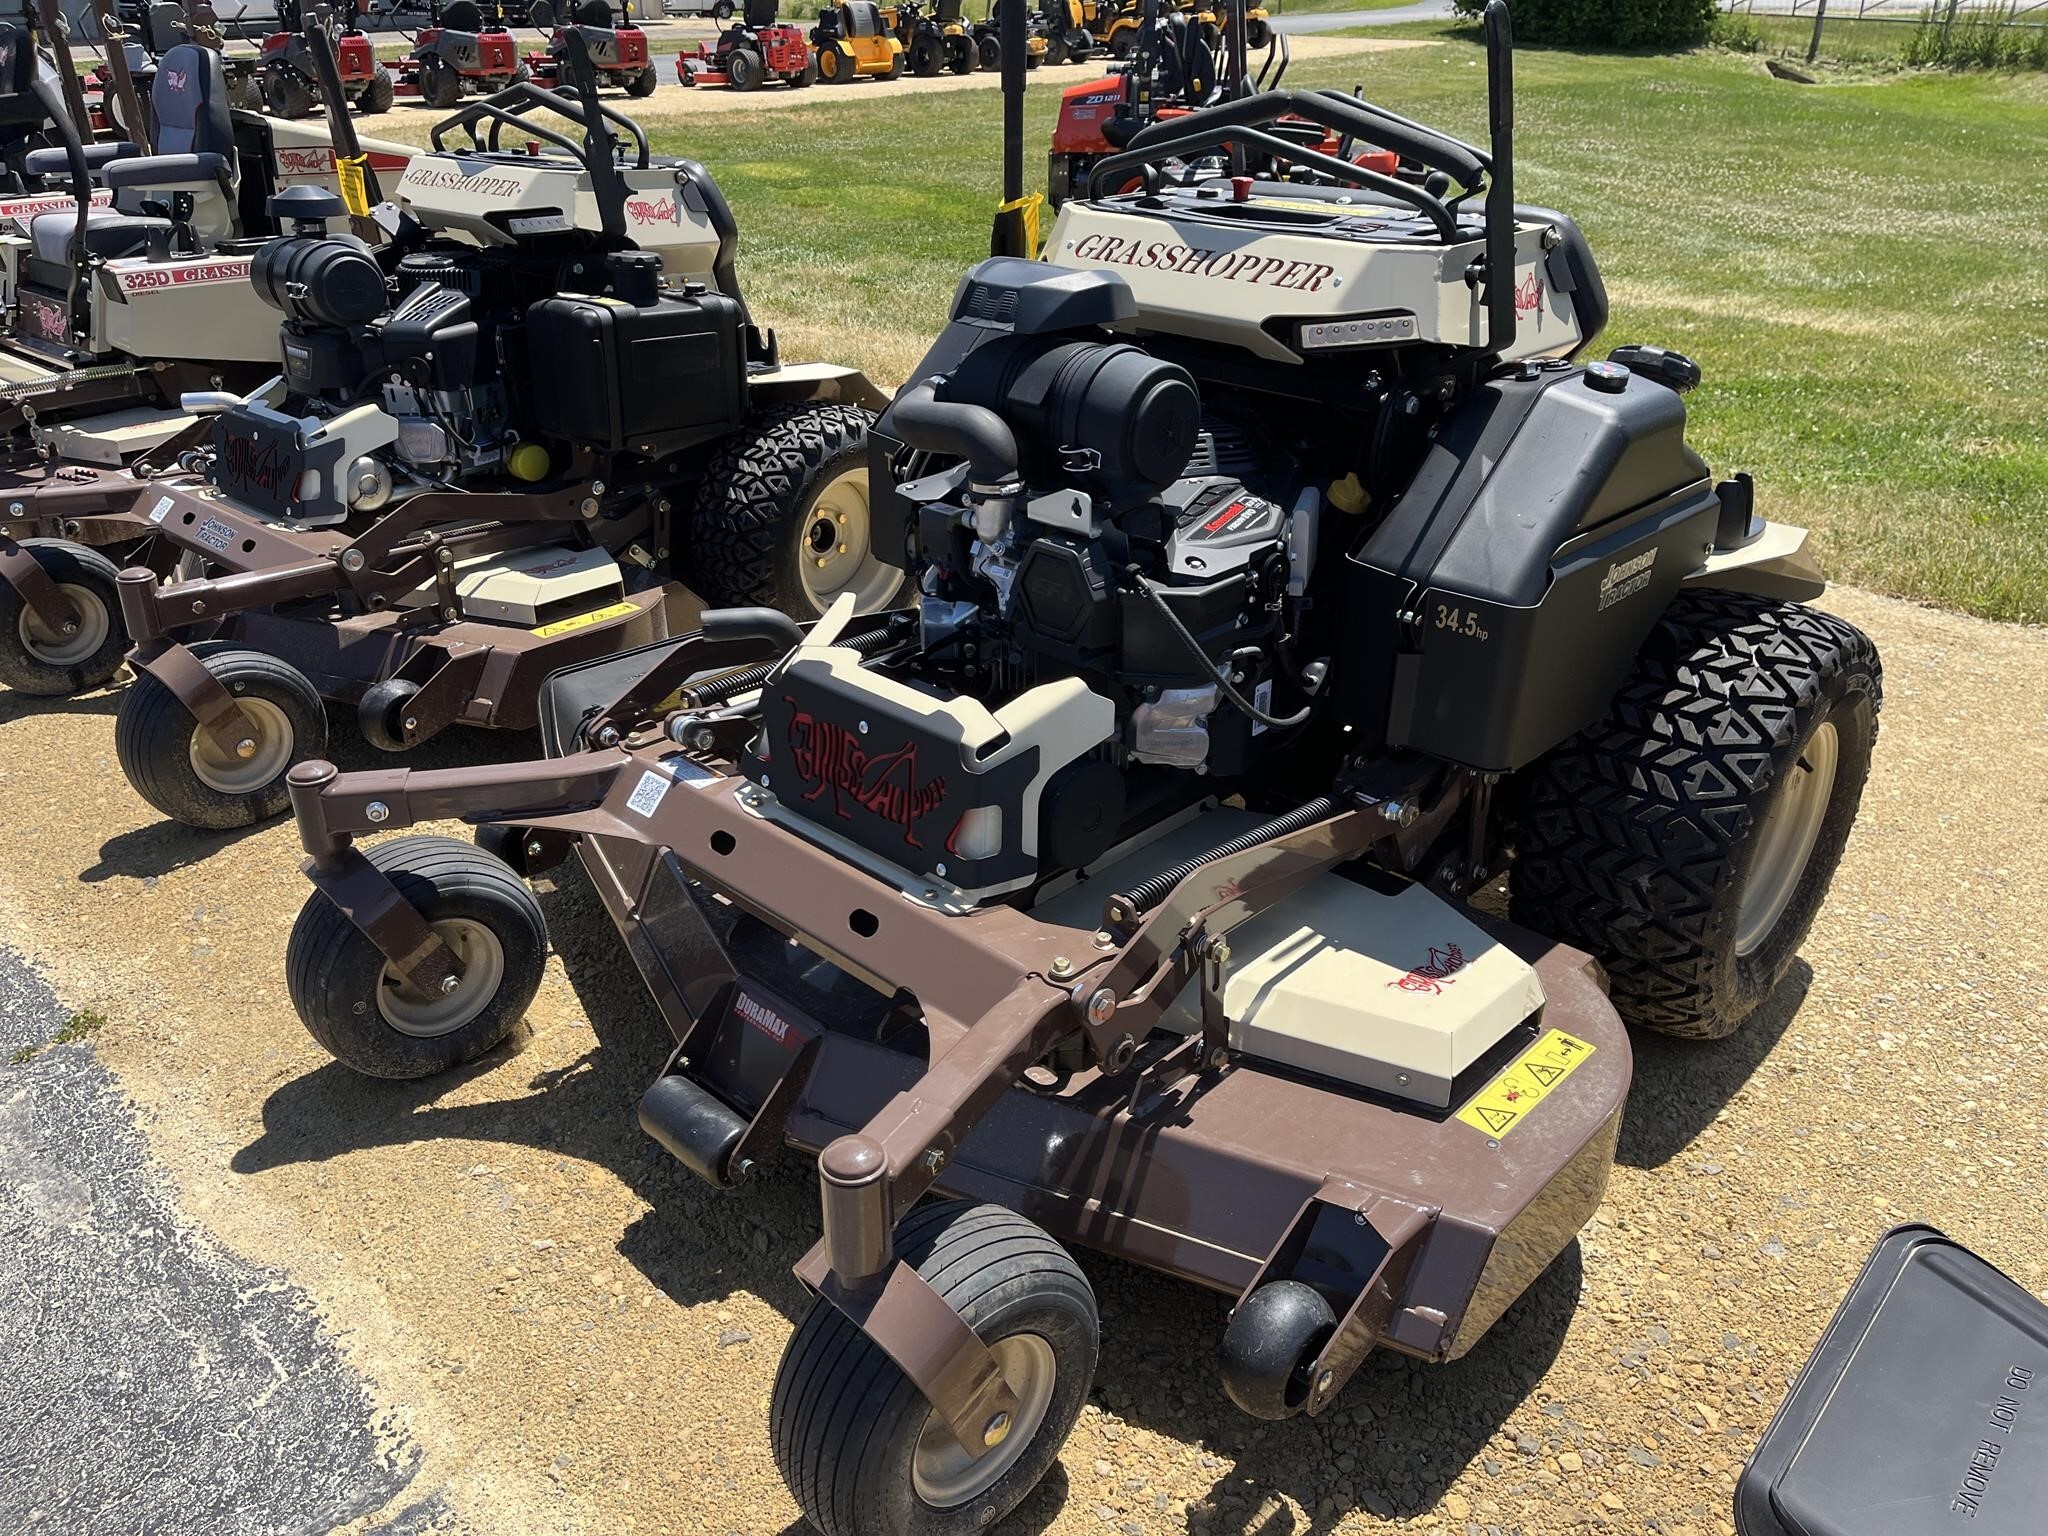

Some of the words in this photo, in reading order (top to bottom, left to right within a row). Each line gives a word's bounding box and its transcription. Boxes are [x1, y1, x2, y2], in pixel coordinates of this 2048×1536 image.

[408, 167, 520, 198] GRASSHOPPER
[124, 270, 170, 289] 325D
[1074, 233, 1335, 293] GRASSHOPPER
[2006, 1364, 2036, 1391] DO
[1989, 1395, 2024, 1435] NOT
[1951, 1439, 2005, 1519] REMOVE
